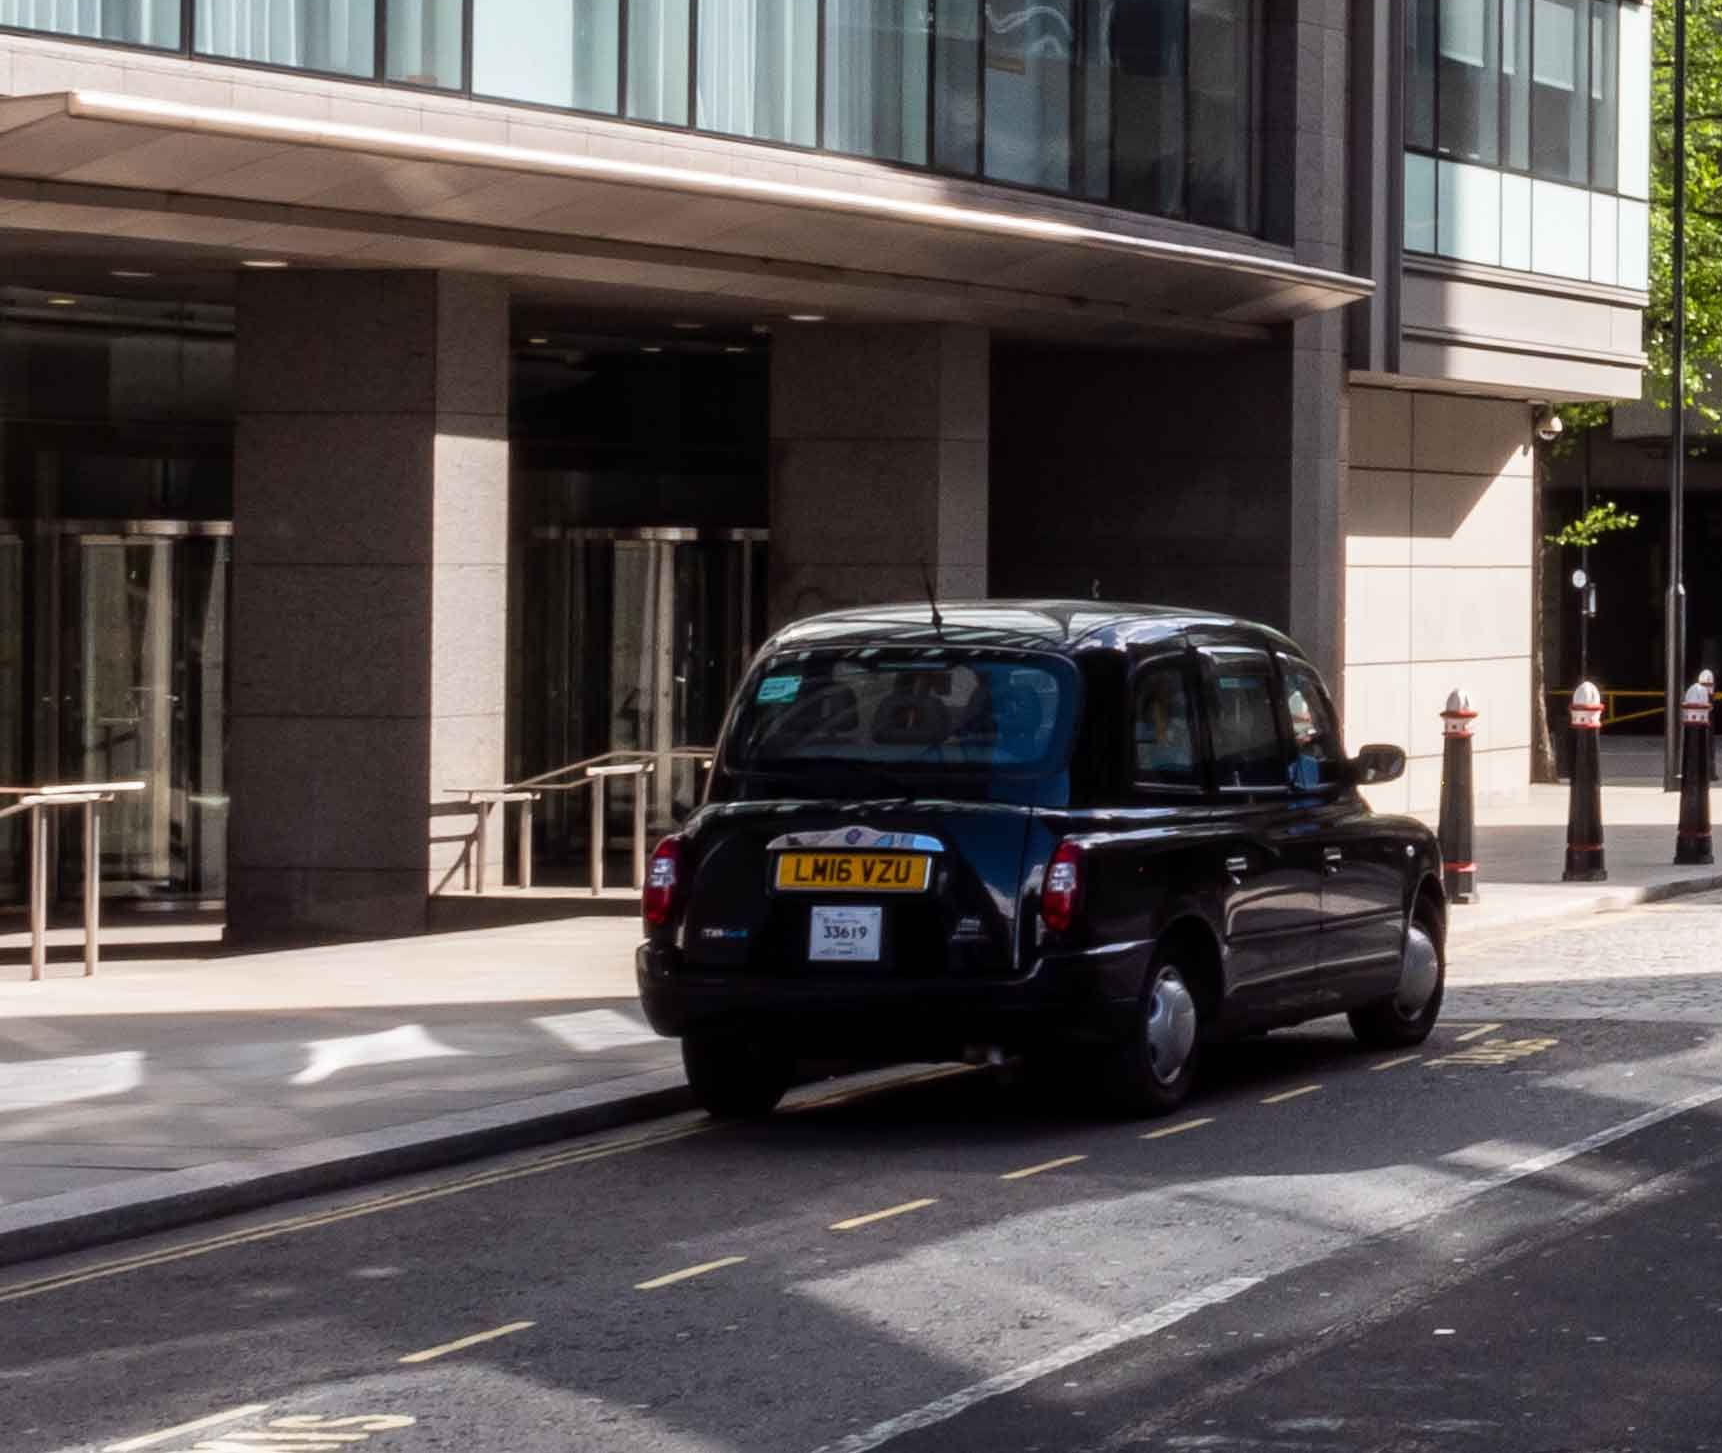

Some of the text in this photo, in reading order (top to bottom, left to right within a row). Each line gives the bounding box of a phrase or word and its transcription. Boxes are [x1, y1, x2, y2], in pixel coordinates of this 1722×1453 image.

[794, 858, 911, 883] LM16 VZU
[823, 926, 868, 940] 33619
